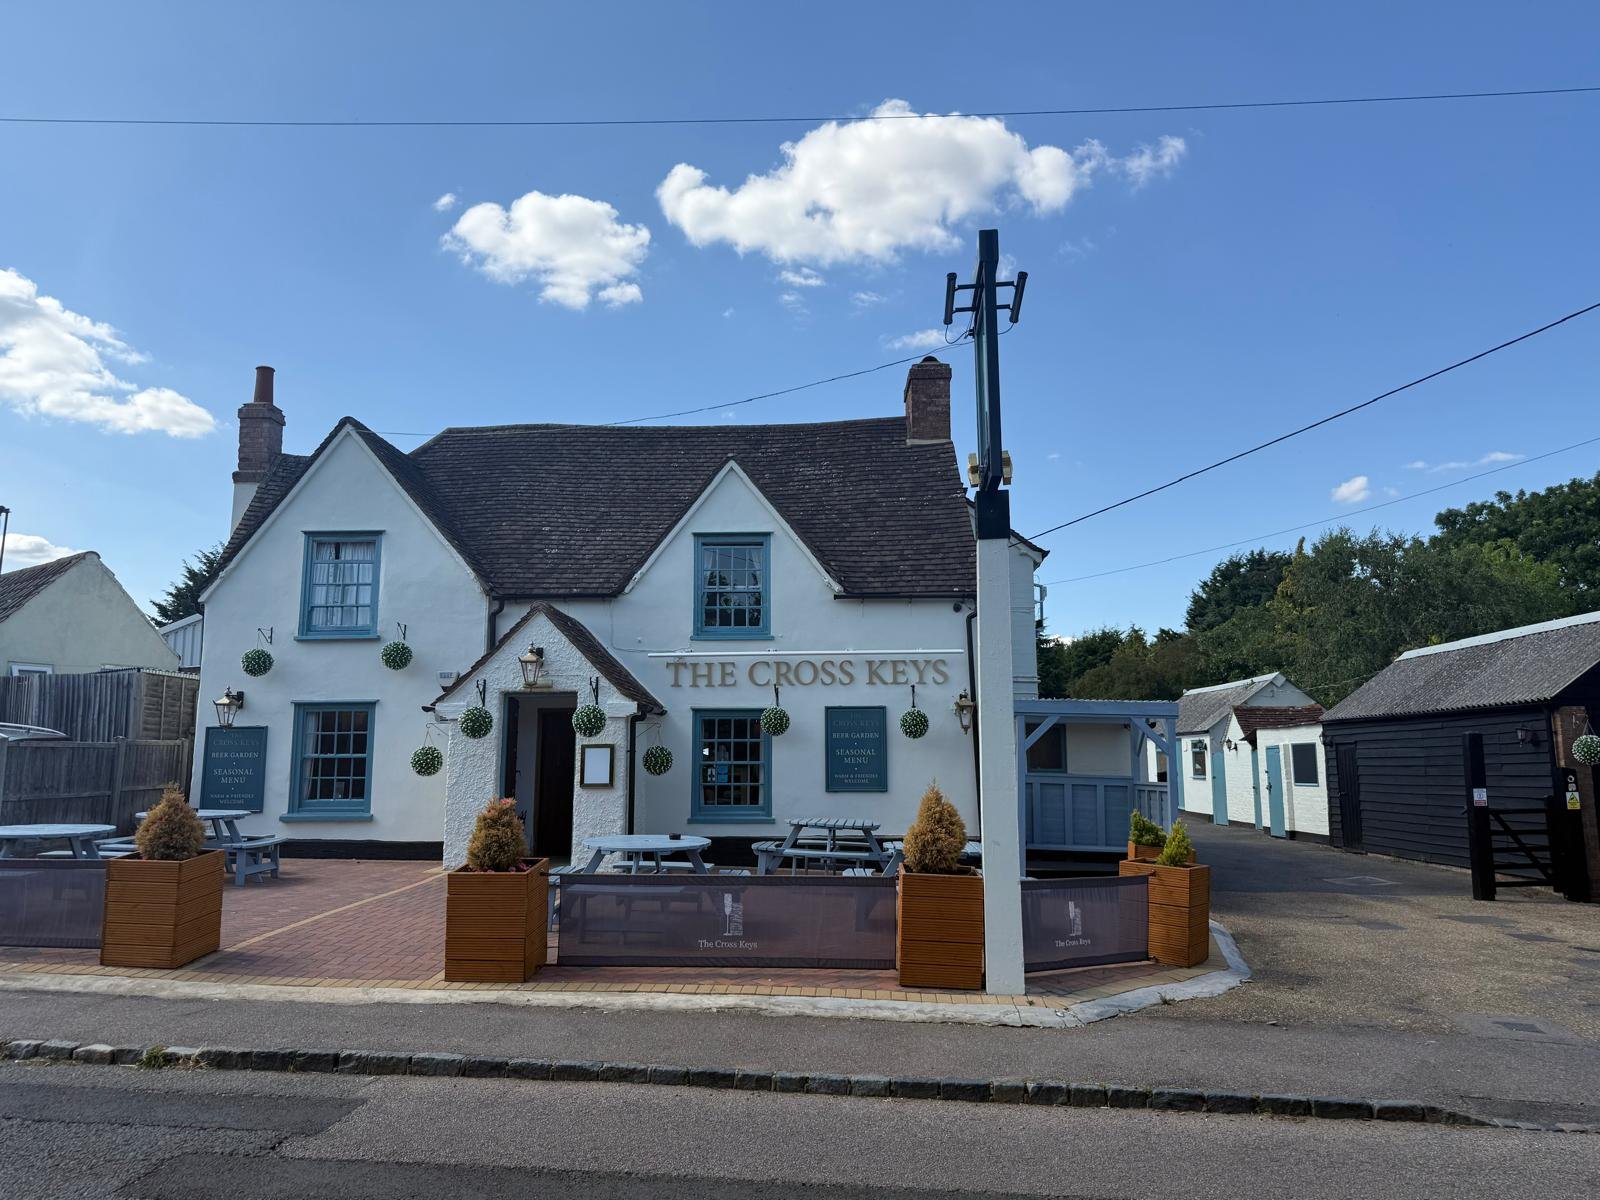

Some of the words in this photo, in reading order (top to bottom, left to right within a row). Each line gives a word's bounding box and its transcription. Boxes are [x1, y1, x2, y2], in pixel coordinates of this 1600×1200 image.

[666, 661, 737, 688] THE
[748, 660, 855, 687] CROSS
[865, 659, 949, 686] KEYS
[211, 751, 229, 759] BEER
[230, 751, 260, 759] GARDEN
[835, 748, 876, 756] SEASONAL
[212, 768, 255, 776] SEASONAL
[220, 776, 246, 784] MENU
[698, 940, 714, 948] The
[715, 940, 738, 948] Cross
[739, 940, 758, 950] Keys
